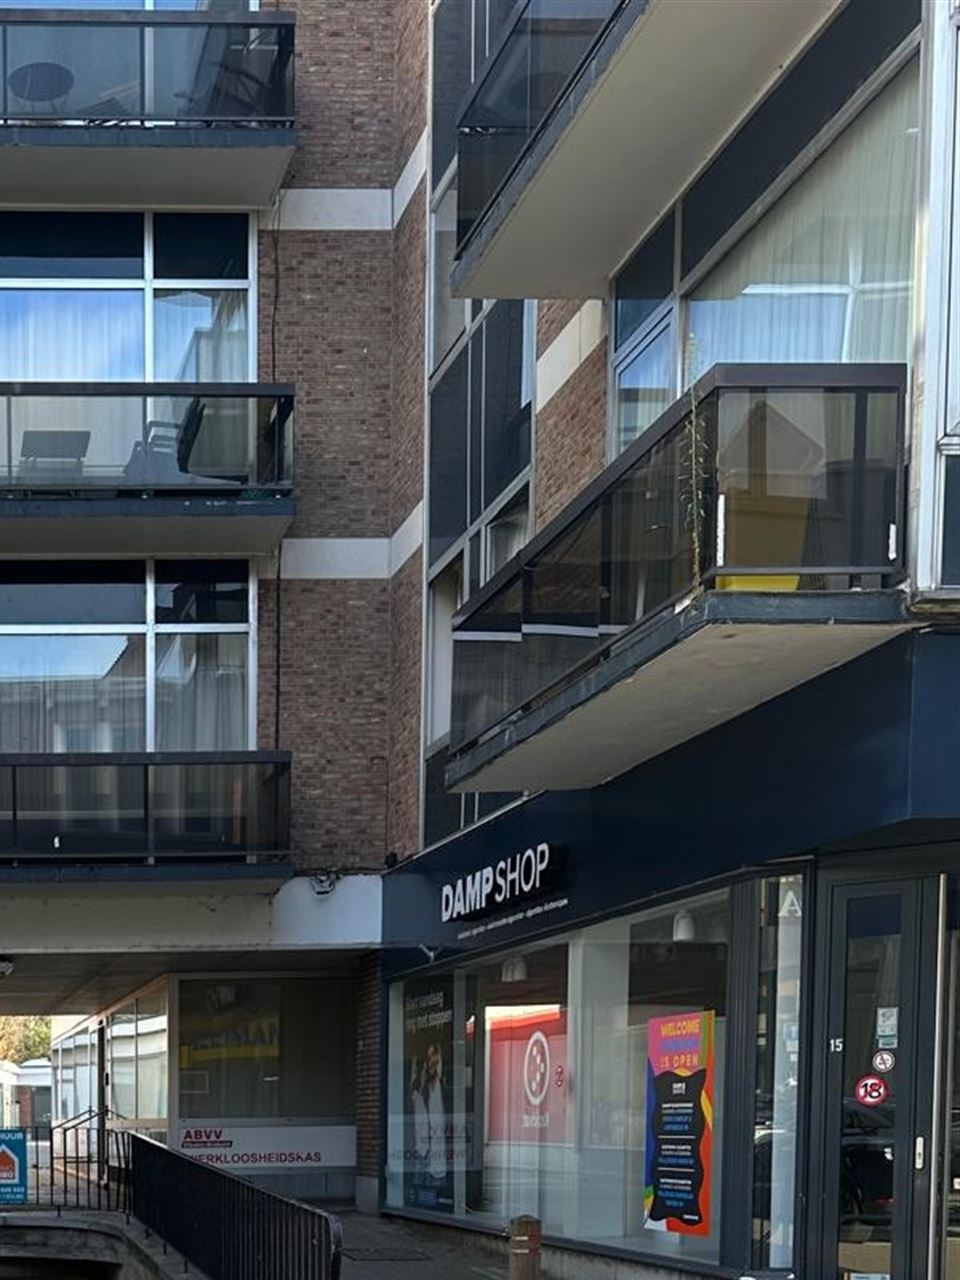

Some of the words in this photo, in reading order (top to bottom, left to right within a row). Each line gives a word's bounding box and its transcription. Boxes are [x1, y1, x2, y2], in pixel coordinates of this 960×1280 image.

[442, 843, 549, 922] DAMPSHOP
[830, 1038, 843, 1052] 15
[673, 1053, 699, 1068] OPEN
[861, 1082, 882, 1099] 18
[184, 1129, 223, 1140] ABVV
